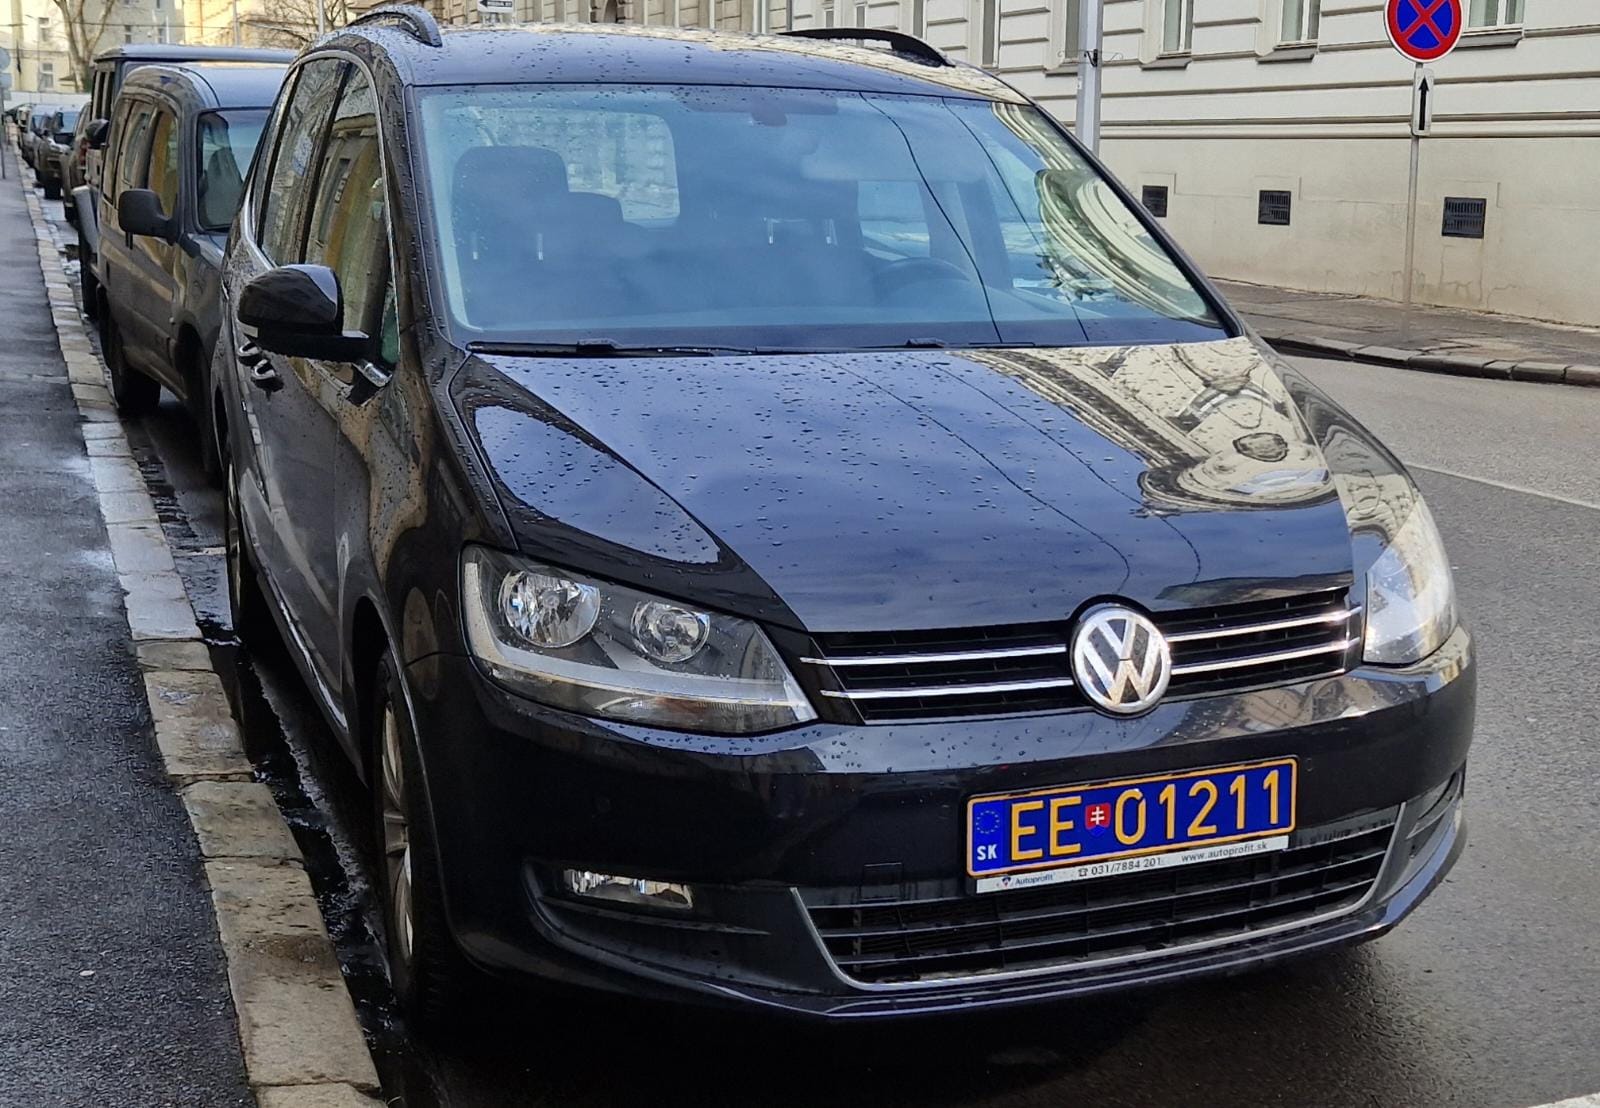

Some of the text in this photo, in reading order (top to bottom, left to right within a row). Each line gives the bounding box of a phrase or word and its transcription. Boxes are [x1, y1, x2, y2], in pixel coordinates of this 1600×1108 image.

[1011, 769, 1279, 861] EE 01211
[977, 844, 998, 861] SK
[1015, 842, 1268, 886] Autoprofit 031/7884 201 www.autoprofit.sk
